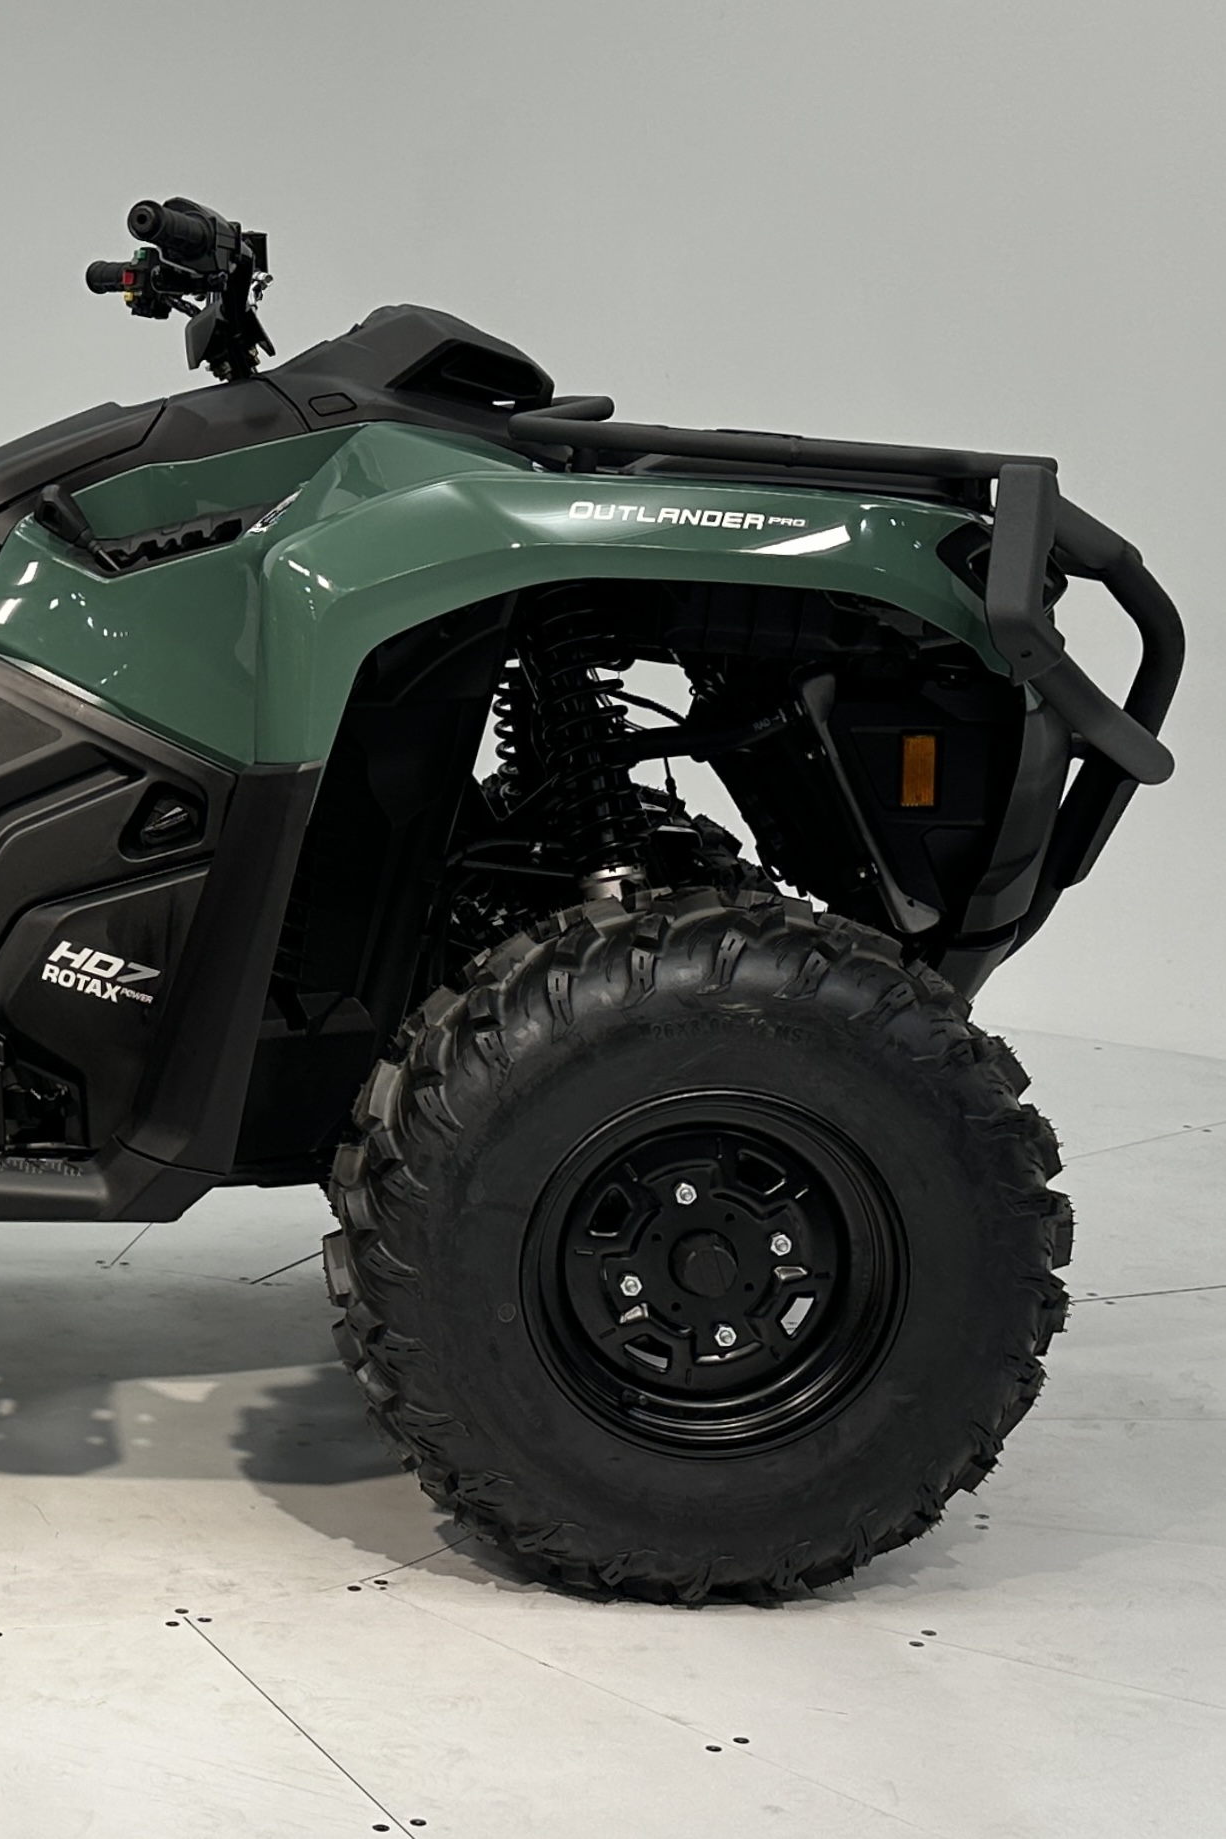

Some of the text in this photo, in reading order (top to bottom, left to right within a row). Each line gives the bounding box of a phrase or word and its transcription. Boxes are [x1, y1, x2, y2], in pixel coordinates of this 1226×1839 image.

[568, 500, 807, 530] OUTLANDER PRO
[47, 940, 161, 983] HD7
[41, 963, 154, 1004] ROTAX POWER
